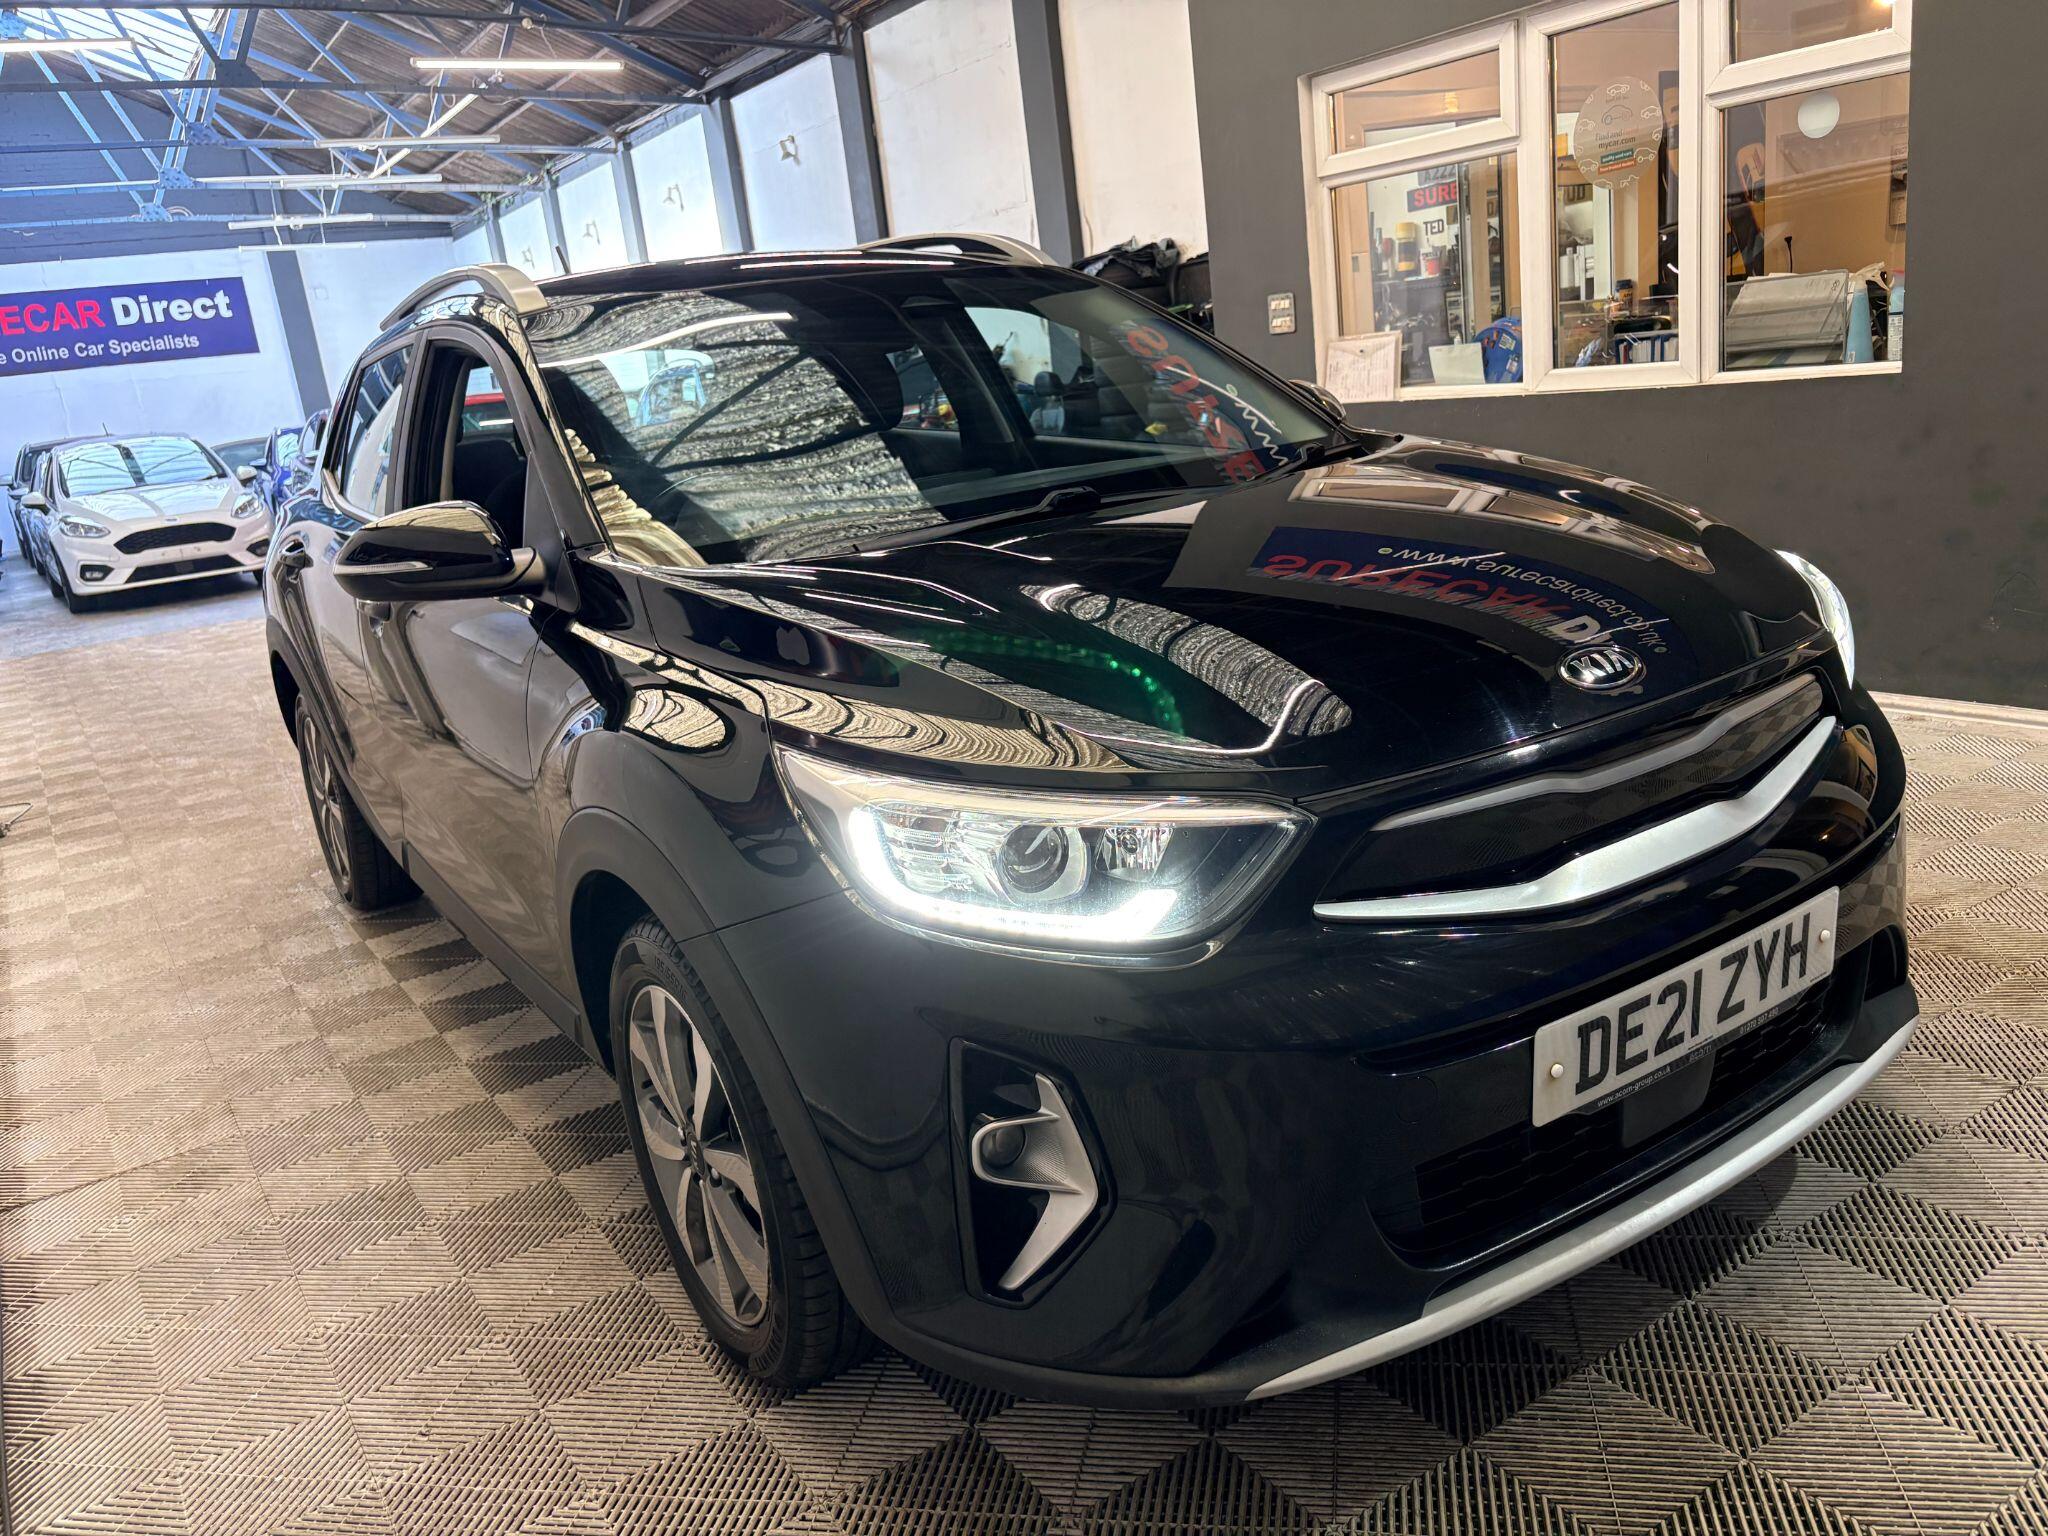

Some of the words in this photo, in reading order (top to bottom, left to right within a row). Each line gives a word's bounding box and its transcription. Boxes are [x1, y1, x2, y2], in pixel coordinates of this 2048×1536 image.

[0, 299, 106, 336] ECAR
[110, 289, 233, 326] Direct
[11, 345, 69, 363] Online
[74, 341, 104, 357] Car
[109, 333, 200, 356] Specialists
[1569, 649, 1634, 683] KIA
[1575, 969, 1703, 1096] DE21
[1716, 912, 1811, 1025] ZYH
[1597, 1064, 1672, 1108] www.acorn-group.co.uk
